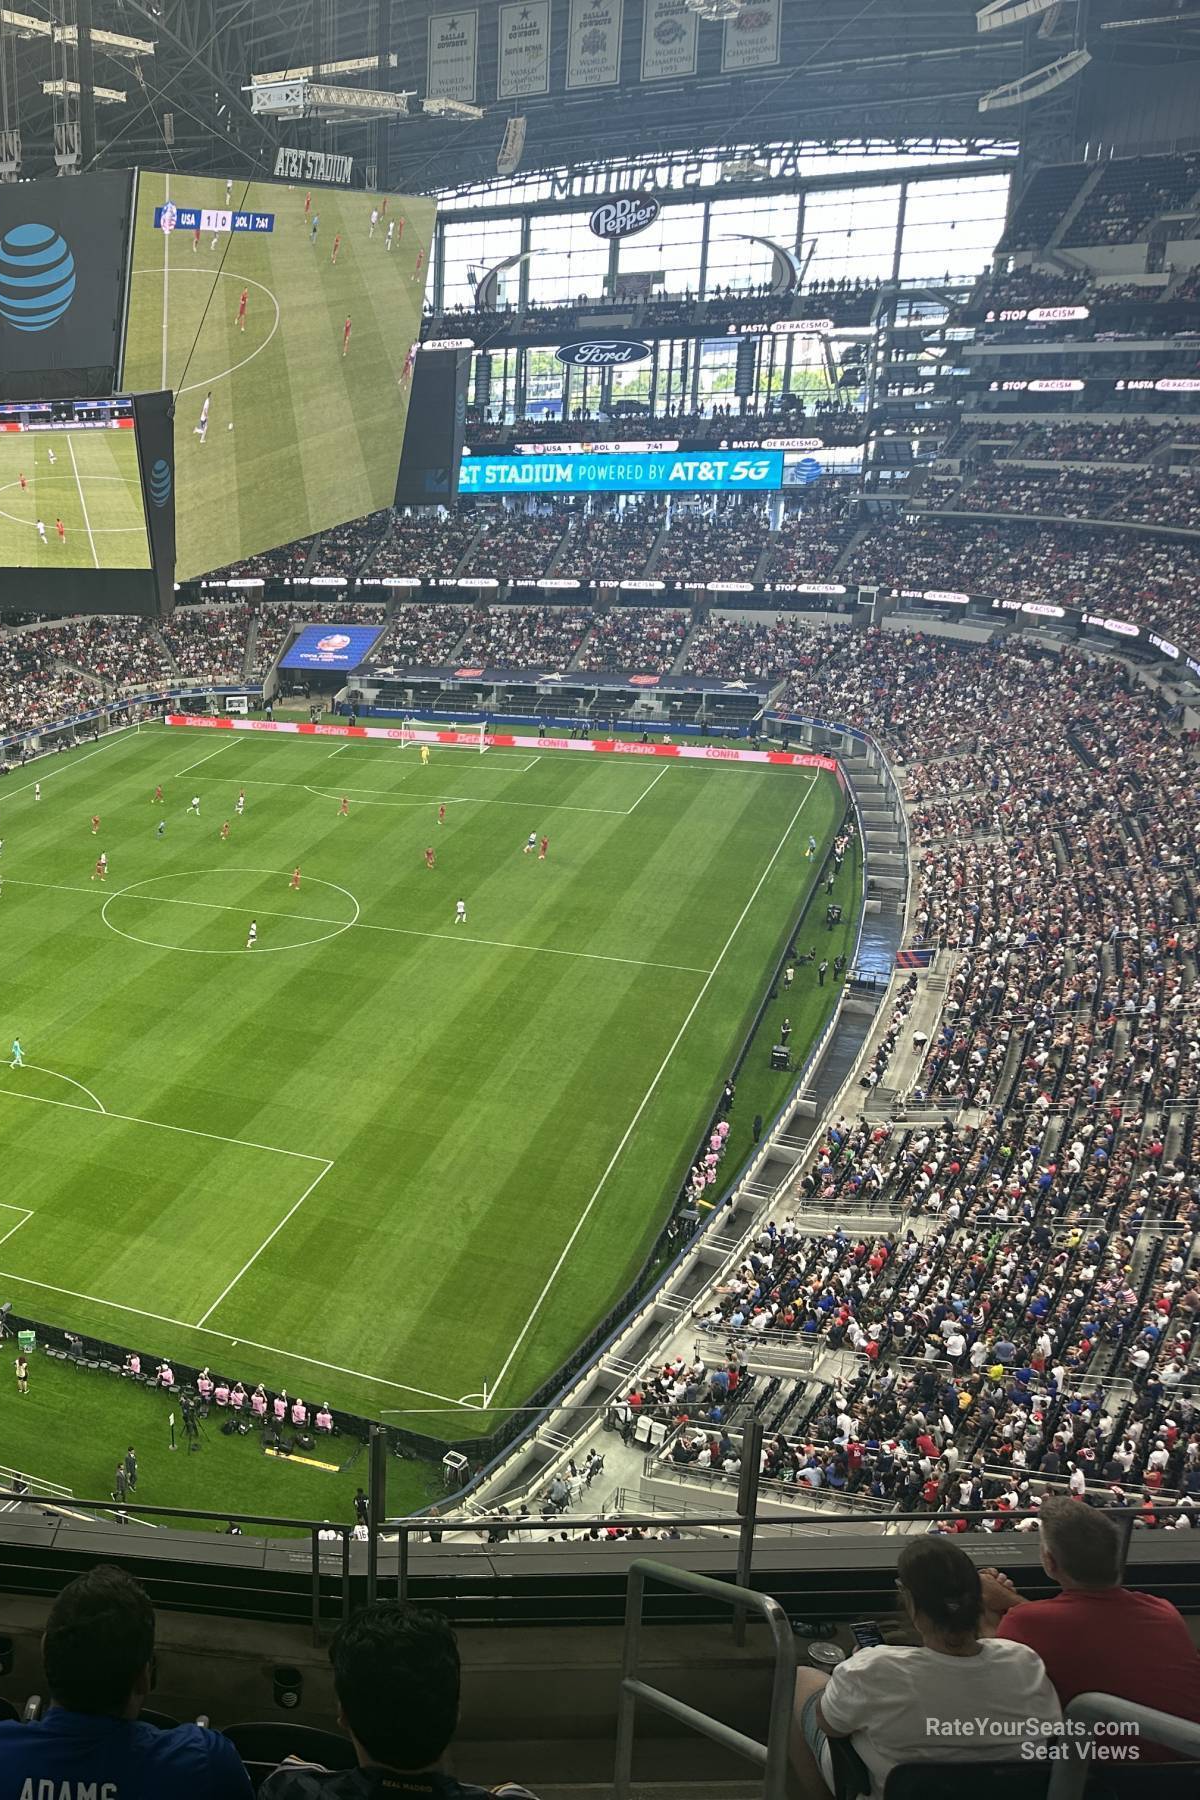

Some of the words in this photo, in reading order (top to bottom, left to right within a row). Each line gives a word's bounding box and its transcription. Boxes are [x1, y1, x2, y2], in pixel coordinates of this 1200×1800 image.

[273, 147, 305, 177] AT&T
[305, 151, 353, 184] STADIUM
[616, 199, 641, 216] Dr
[181, 213, 196, 226] USA
[206, 215, 211, 227] 1
[221, 216, 227, 227] 0
[591, 201, 656, 235] Pepper
[999, 310, 1027, 321] STOP
[1039, 310, 1075, 318] RACISM
[740, 324, 768, 333] BASTA
[776, 322, 789, 330] DE
[791, 320, 829, 330] RACISMO
[431, 340, 463, 349] RACISM
[574, 343, 632, 364] Ford
[1002, 381, 1027, 390] STOP
[1038, 381, 1072, 389] RACISM
[1127, 381, 1154, 389] BASTA
[1172, 380, 1200, 388] RACISM
[545, 444, 562, 452] USA
[568, 443, 572, 451] 1
[594, 443, 609, 451] BOL
[614, 443, 620, 451] 0
[647, 442, 663, 450] 7:41
[732, 440, 759, 449] BASTA
[766, 440, 779, 448] DE
[458, 466, 480, 484] &T
[485, 463, 573, 484] STADIUM
[579, 464, 643, 481] POWERED
[648, 464, 665, 480] BY
[669, 461, 727, 481] AT&T
[729, 461, 770, 480] 5G
[599, 580, 619, 588] STOP
[775, 584, 797, 592] STOP
[901, 590, 923, 598] BASTA
[1002, 600, 1022, 609] STOP
[1029, 605, 1056, 614] RACISM
[315, 725, 350, 737] Betano
[614, 742, 656, 754] Betano
[705, 749, 739, 760] CONFIA
[358, 1530, 367, 1539] 16
[19, 1776, 118, 1800] ADAMS
